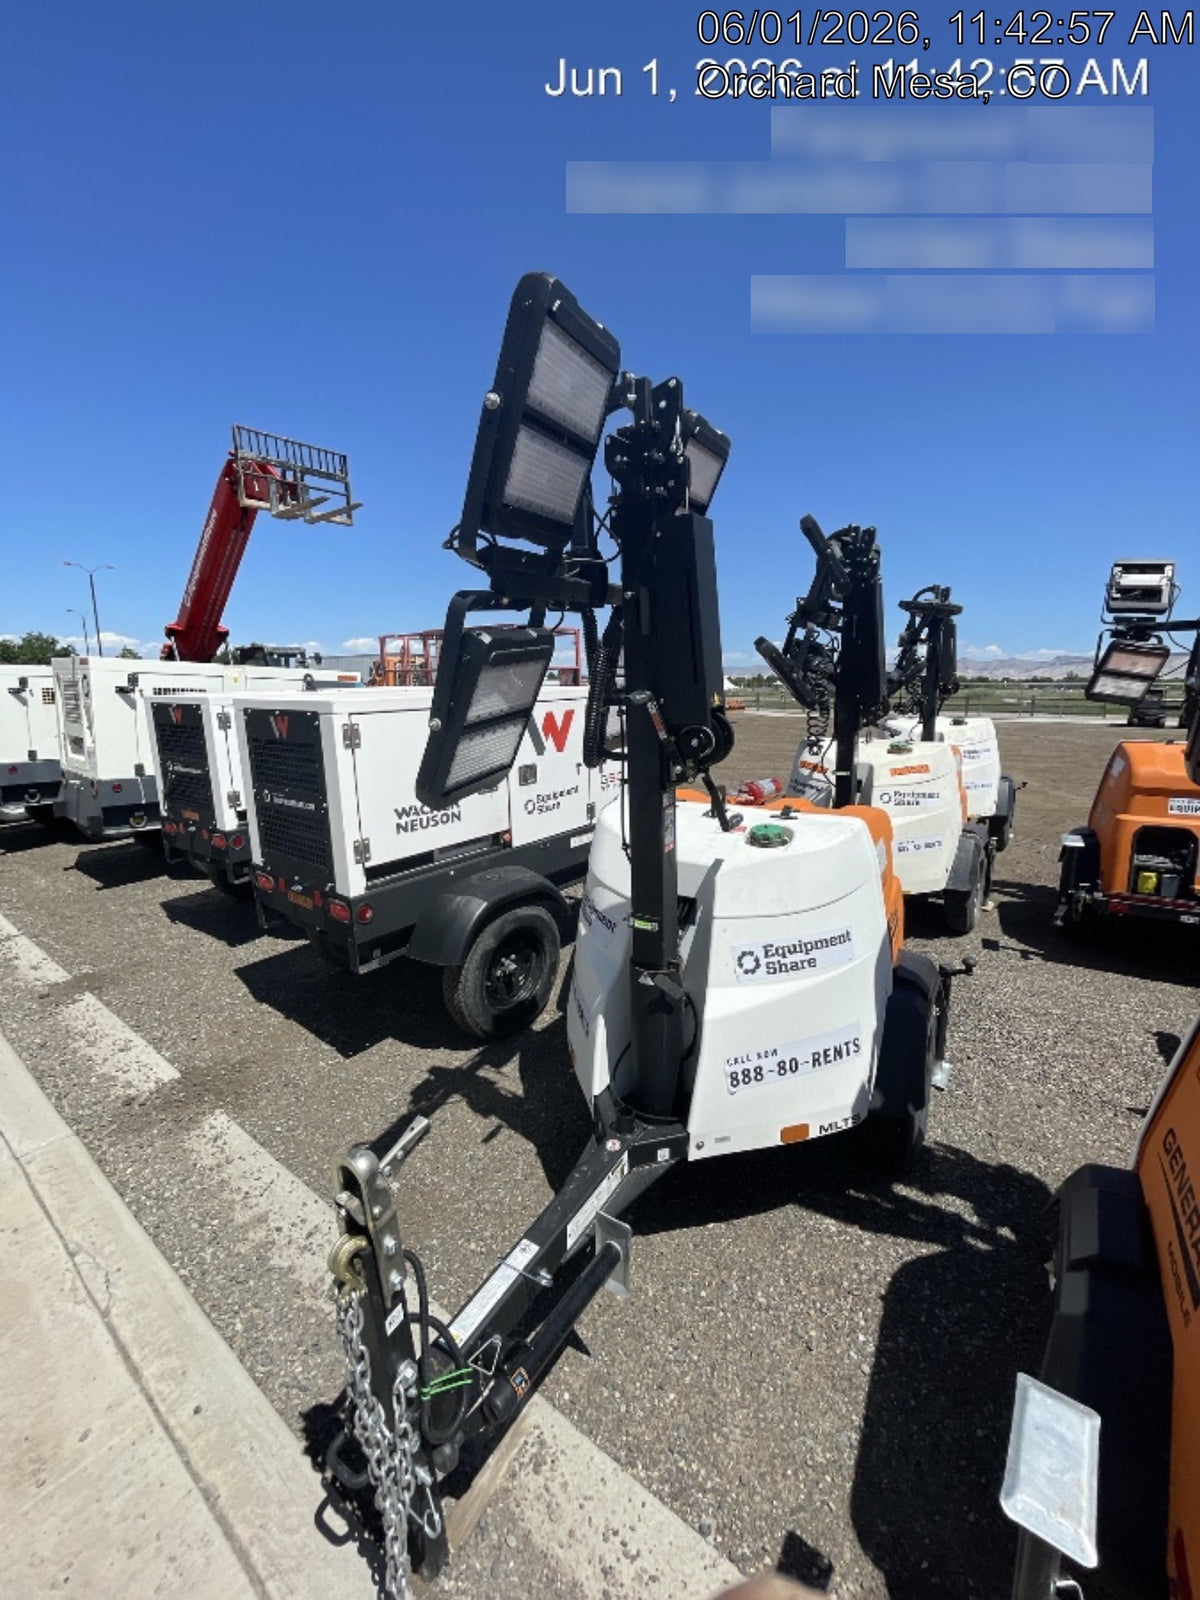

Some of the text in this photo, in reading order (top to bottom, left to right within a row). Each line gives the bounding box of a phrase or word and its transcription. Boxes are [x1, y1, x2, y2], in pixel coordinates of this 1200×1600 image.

[396, 809, 462, 836] NEUSON
[762, 929, 852, 959] Equipment
[766, 957, 817, 975] Share
[729, 1037, 861, 1089] 888-80-RENTS
